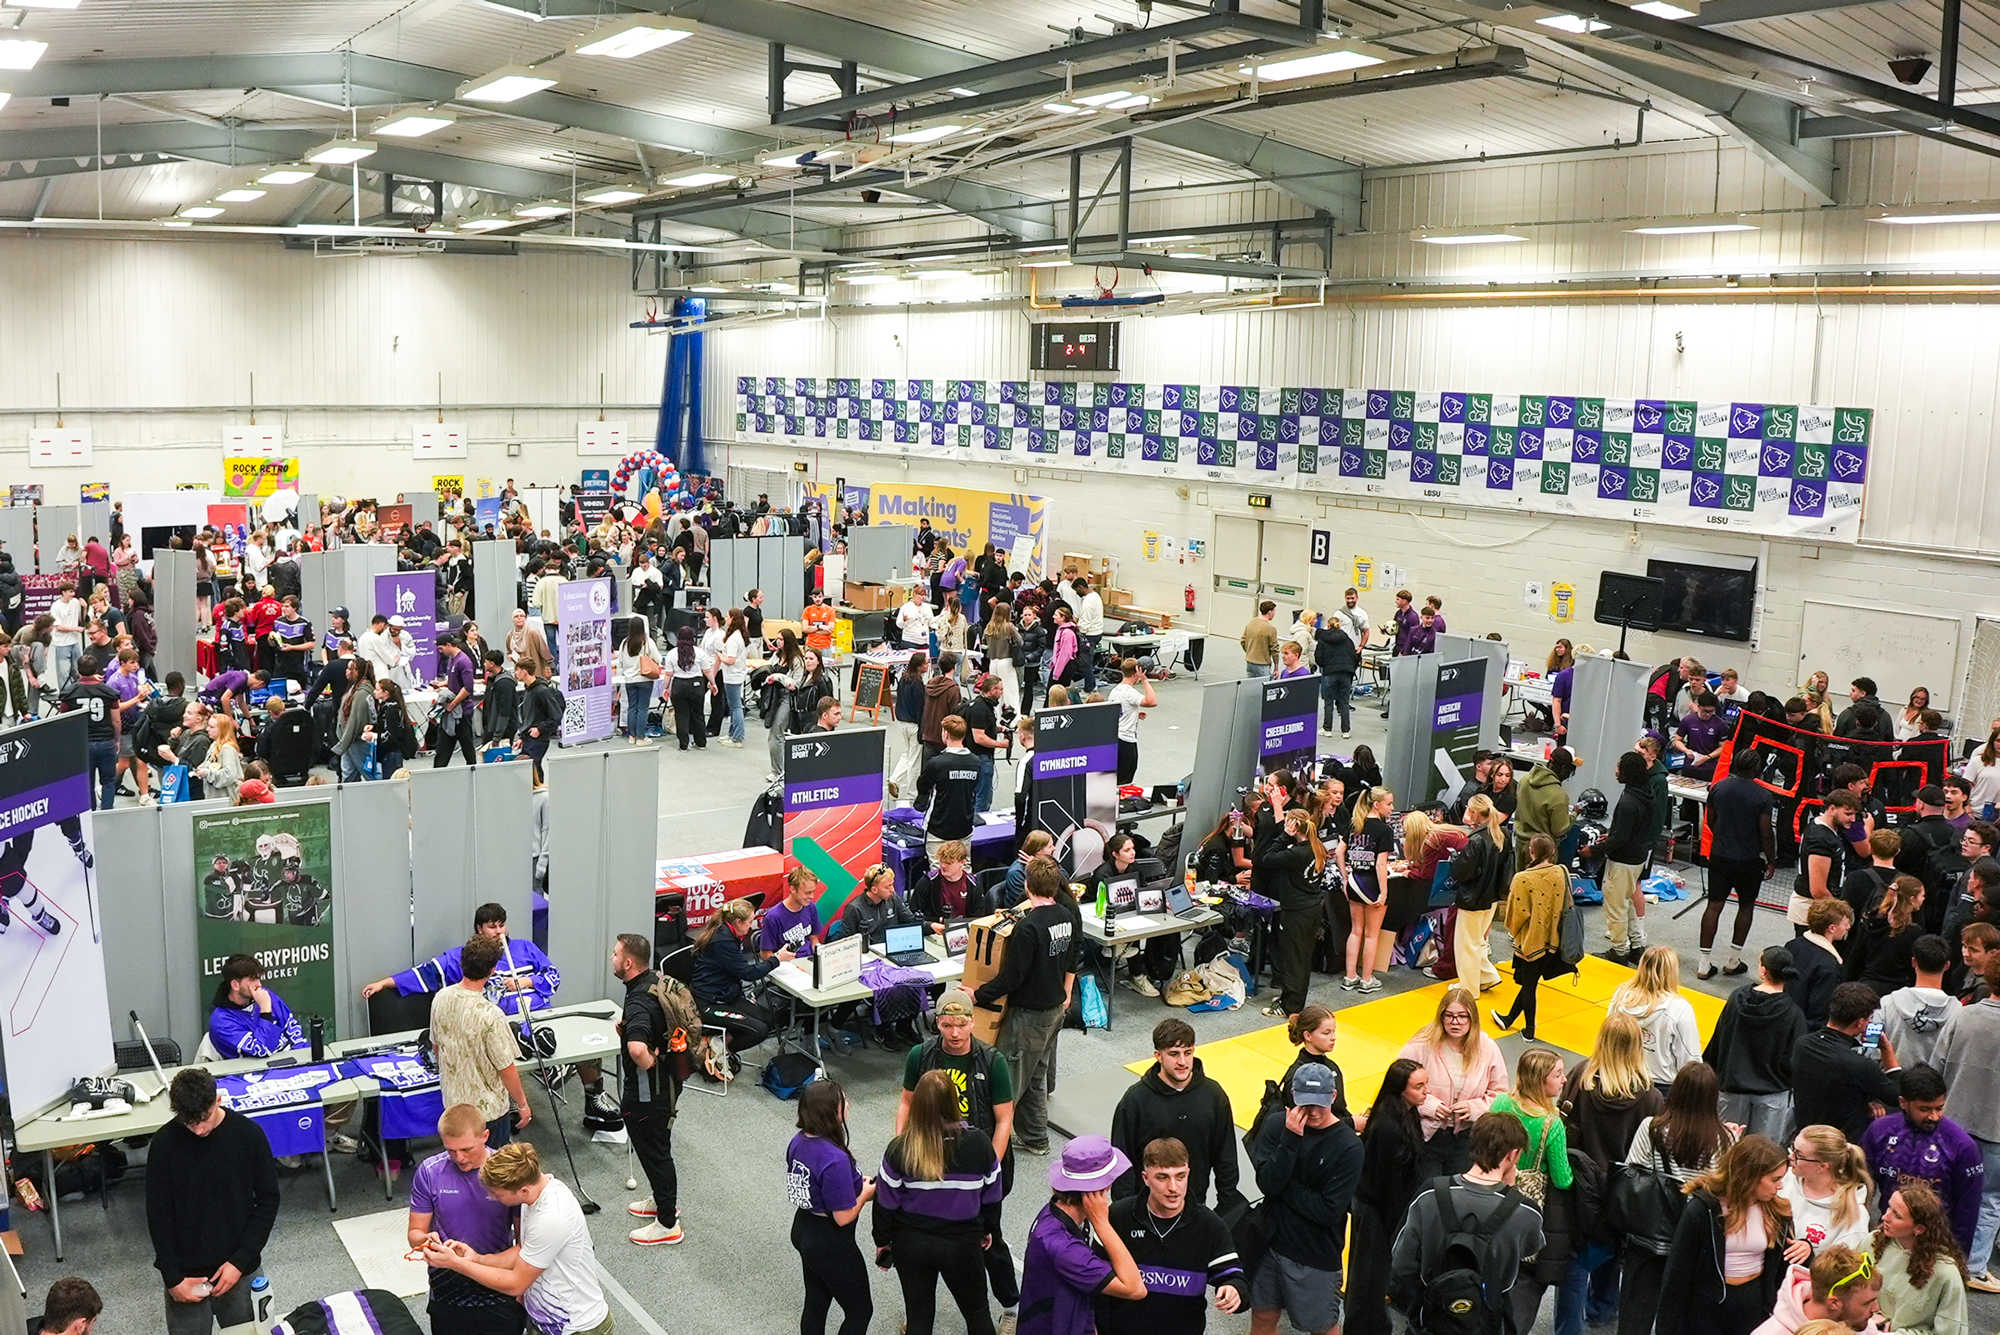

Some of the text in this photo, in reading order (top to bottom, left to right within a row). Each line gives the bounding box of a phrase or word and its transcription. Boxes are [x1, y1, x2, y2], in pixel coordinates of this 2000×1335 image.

[838, 480, 844, 498] A
[879, 495, 957, 524] Making
[1707, 516, 1728, 524] LBSU
[1315, 534, 1326, 560] B
[564, 591, 587, 600] Education
[567, 603, 584, 612] Society
[1265, 722, 1304, 738] CHEERLEADING
[792, 743, 814, 752] BECKETT
[1265, 737, 1282, 749] MATCH
[792, 751, 808, 759] SPORT
[1040, 755, 1087, 772] GYMNASTICS
[791, 787, 839, 804] ATHLETICS
[12, 798, 49, 825] HOCKEY
[687, 880, 725, 895] 100%
[687, 892, 724, 910] me
[254, 943, 329, 967] GRYPHONS
[1130, 1230, 1146, 1238] OW
